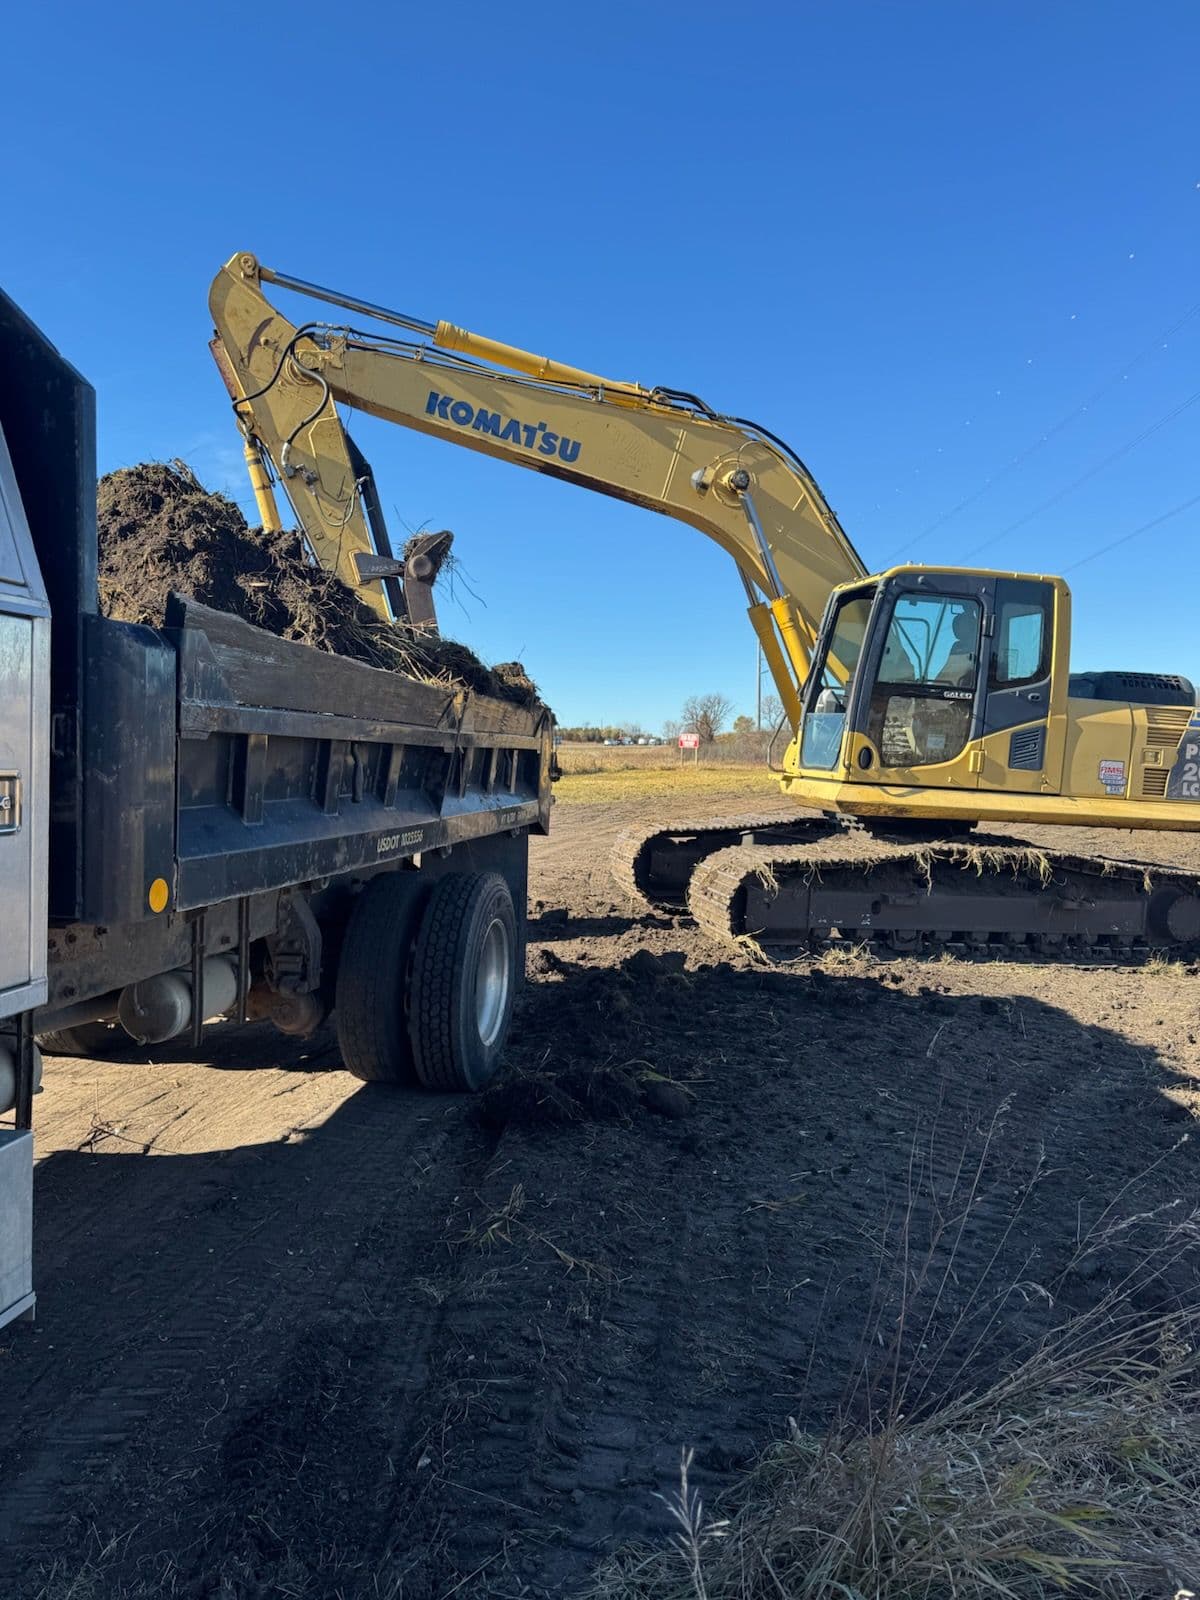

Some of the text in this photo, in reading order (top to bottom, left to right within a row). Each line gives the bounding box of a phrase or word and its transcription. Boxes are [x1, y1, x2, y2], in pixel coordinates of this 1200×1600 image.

[425, 390, 581, 463] KOMATSU
[1185, 743, 1200, 760] P
[1182, 762, 1200, 782] 2
[376, 834, 400, 853] USDOT
